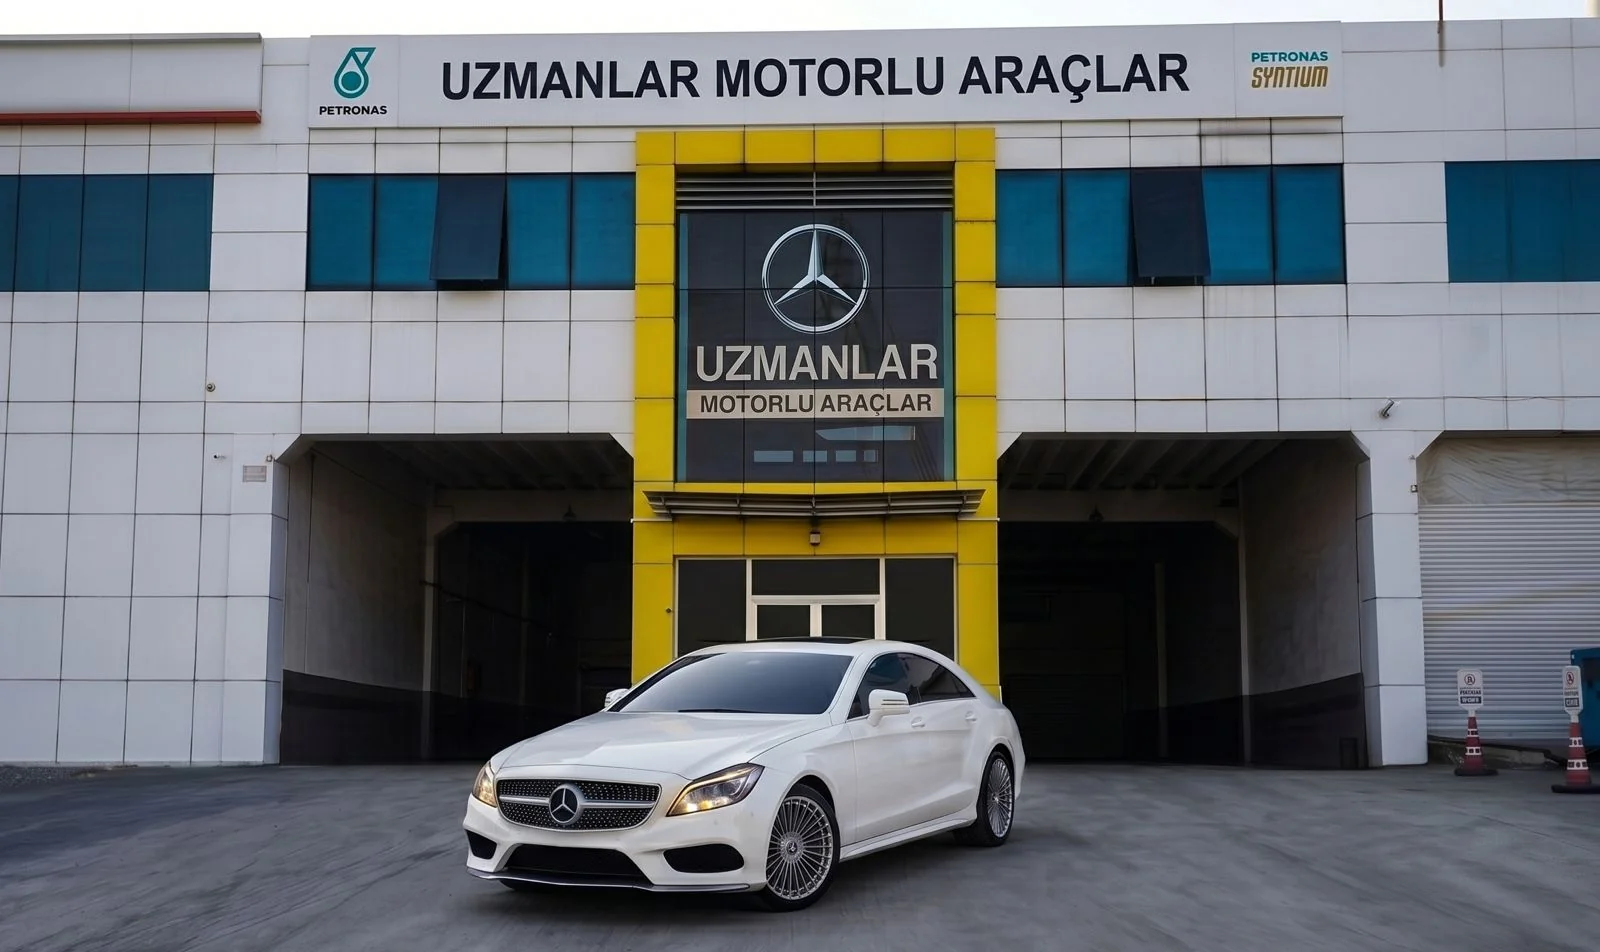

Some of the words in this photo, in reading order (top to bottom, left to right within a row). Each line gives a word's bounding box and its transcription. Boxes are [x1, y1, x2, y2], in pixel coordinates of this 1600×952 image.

[1251, 51, 1329, 62] PETRONAS
[442, 60, 701, 101] UZMANLAR
[716, 57, 944, 98] MOTORLU
[958, 54, 1191, 104] ARAÇLAR
[1251, 66, 1329, 88] SYNTIUM
[319, 105, 388, 115] PETRONAS
[696, 343, 938, 382] UZMANLAR
[700, 395, 814, 414] MOTORLU
[820, 393, 932, 416] ARAÇLAR
